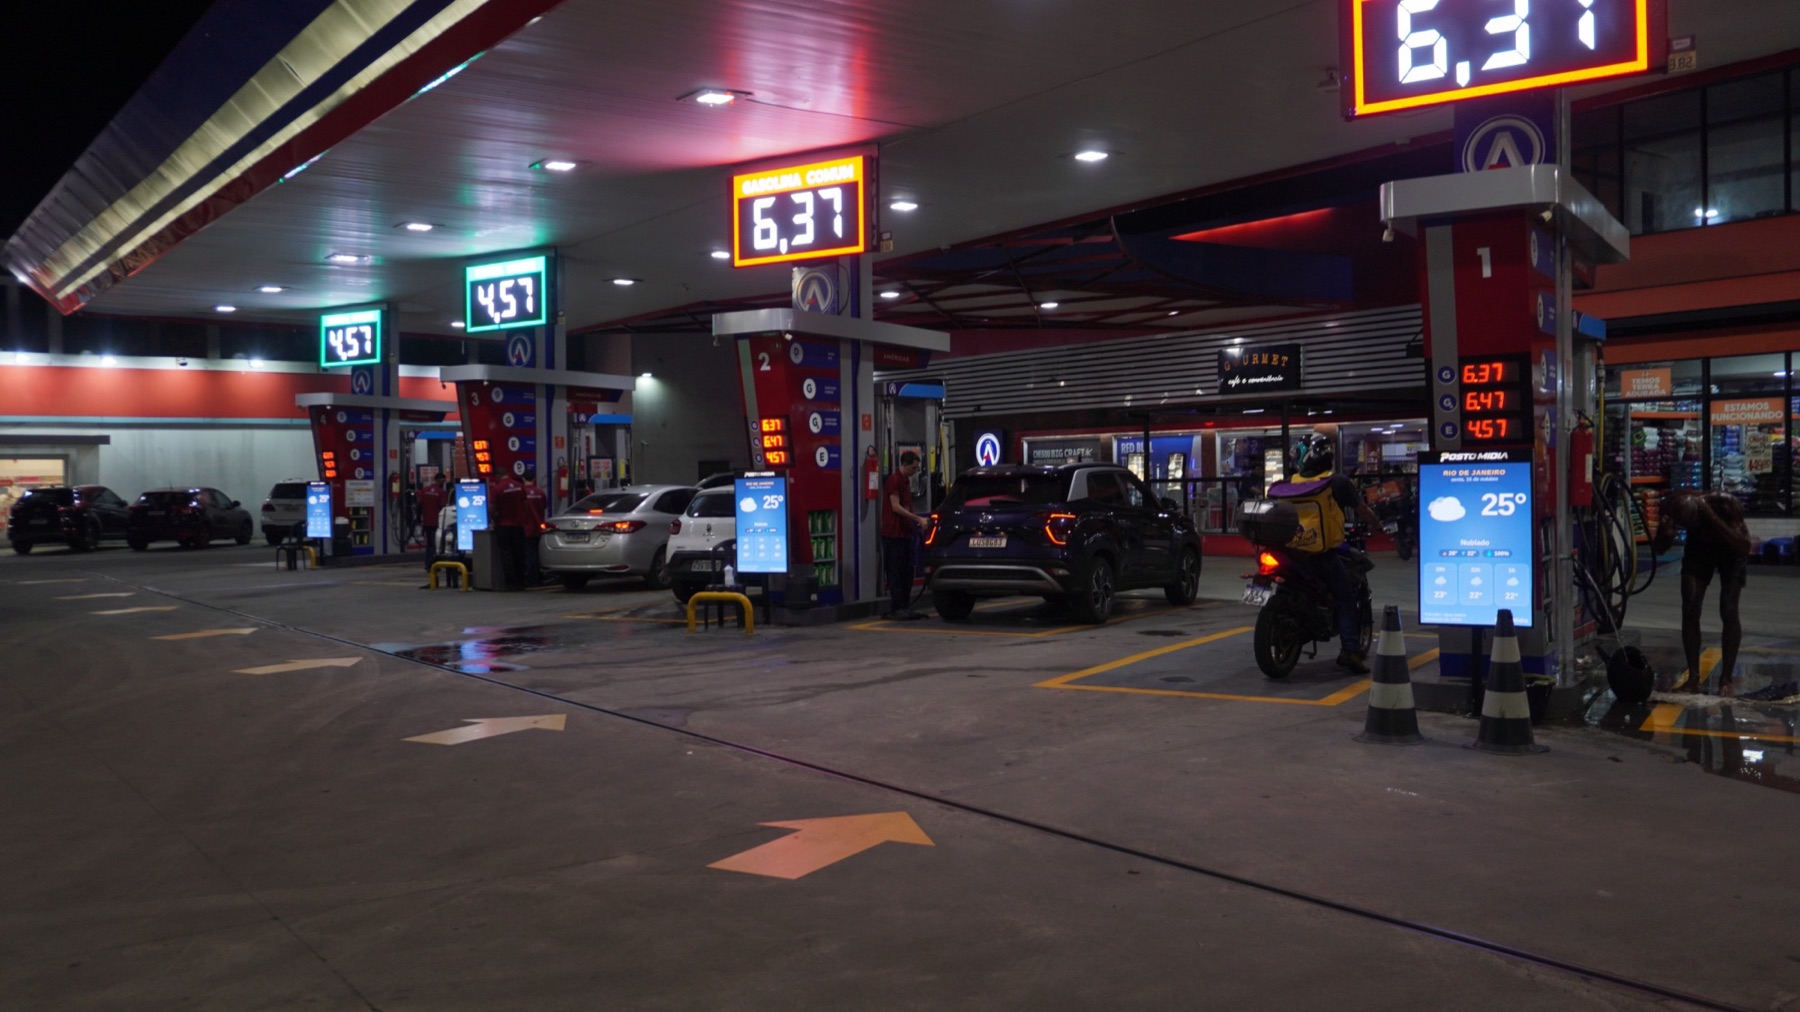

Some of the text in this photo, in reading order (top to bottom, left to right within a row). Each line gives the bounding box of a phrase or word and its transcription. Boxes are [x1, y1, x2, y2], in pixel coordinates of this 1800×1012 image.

[742, 163, 854, 195] GASOLINA COMUM
[753, 187, 843, 255] 6,37
[1476, 247, 1492, 278] 1
[478, 277, 534, 324] 4,57
[329, 325, 372, 362] 4,57
[758, 352, 771, 371] 2
[1442, 370, 1451, 379] G
[1632, 377, 1661, 385] TEMOS
[1626, 389, 1666, 398] ADUBADA
[1724, 402, 1769, 412] ESTAMOS
[1711, 411, 1784, 421] FUNCIONANDO
[1445, 426, 1453, 435] E
[1121, 441, 1153, 454] RED BUL
[819, 452, 825, 462] E
[1051, 449, 1063, 458] BIG
[1440, 452, 1508, 462] POSTO MIDIA
[763, 495, 784, 510] 25°
[1481, 492, 1527, 516] 25°
